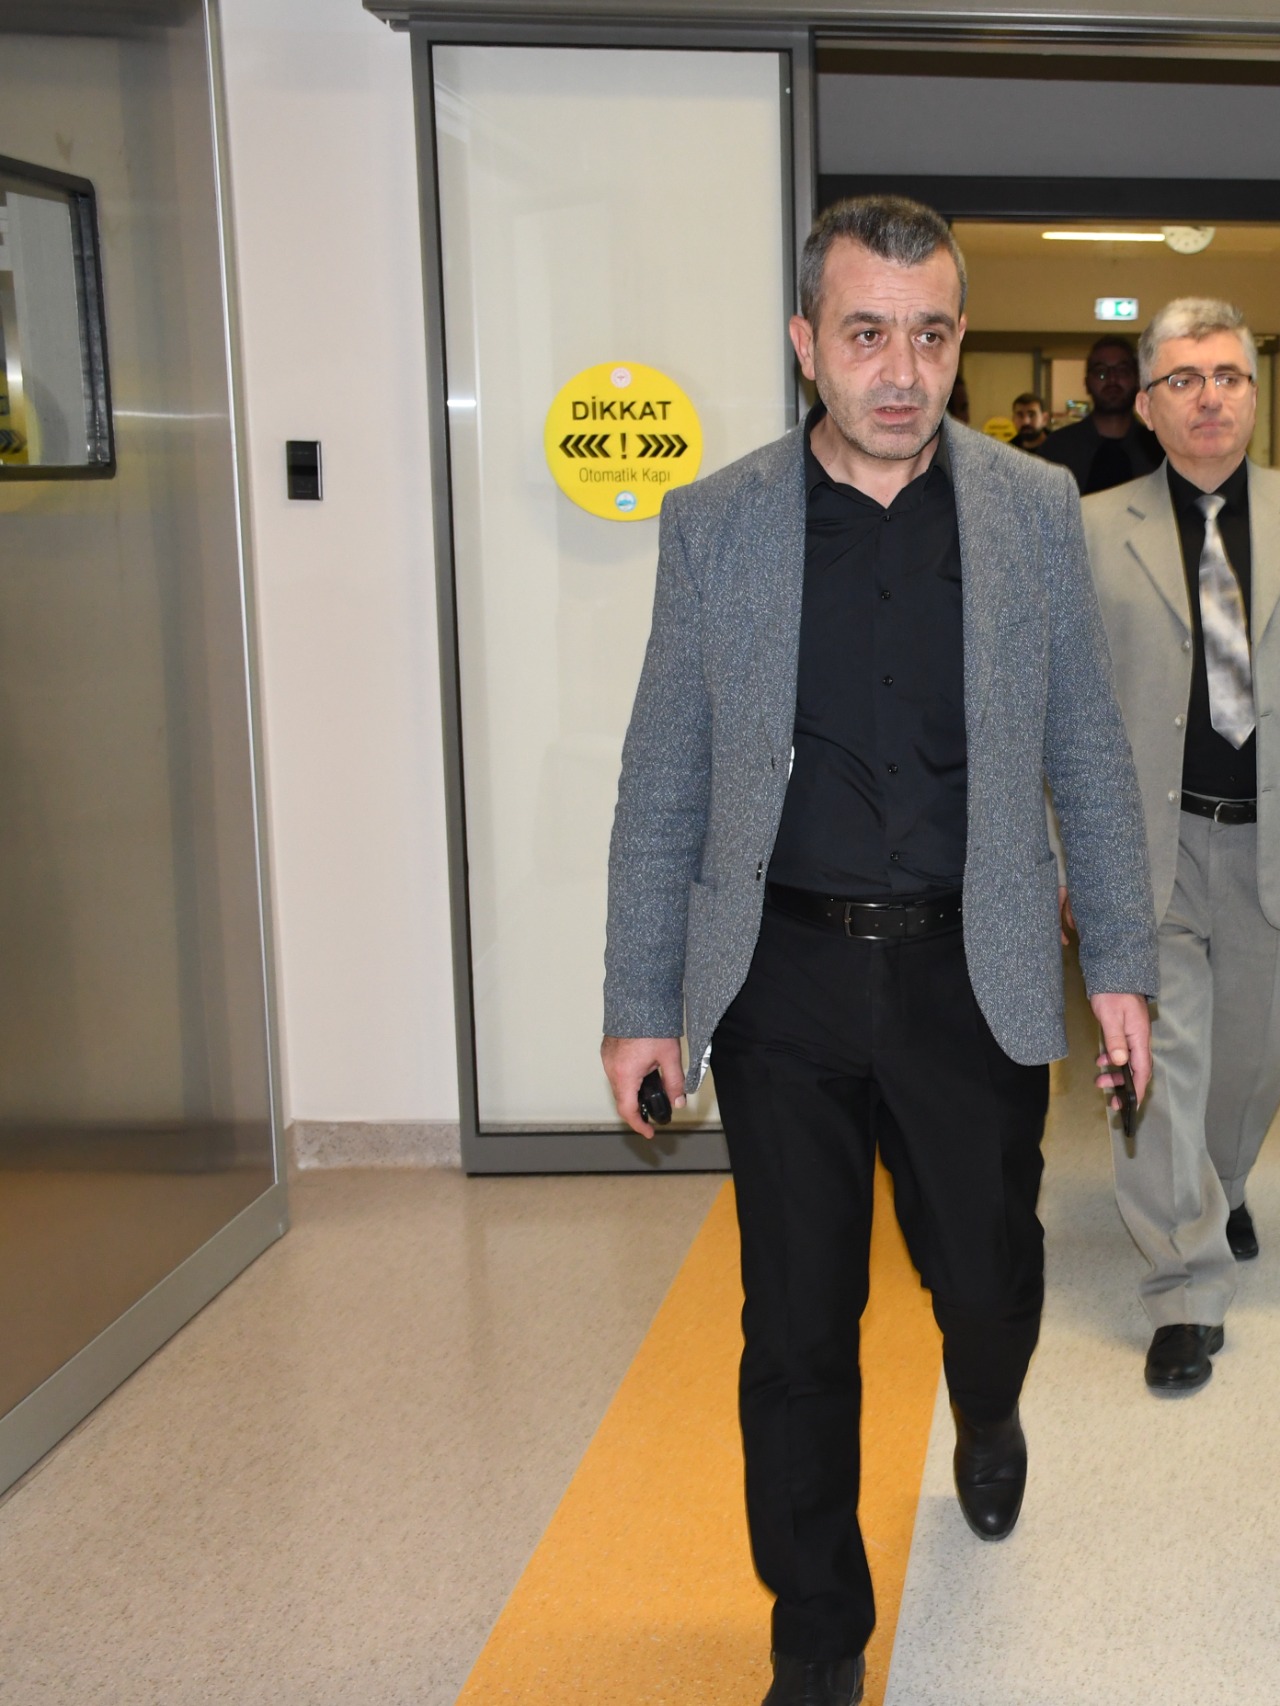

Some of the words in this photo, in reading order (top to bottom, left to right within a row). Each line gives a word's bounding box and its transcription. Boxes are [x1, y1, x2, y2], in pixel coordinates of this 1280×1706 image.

[572, 396, 672, 421] DİKKAT
[579, 467, 638, 483] Otomatik
[642, 468, 671, 484] Kapı
